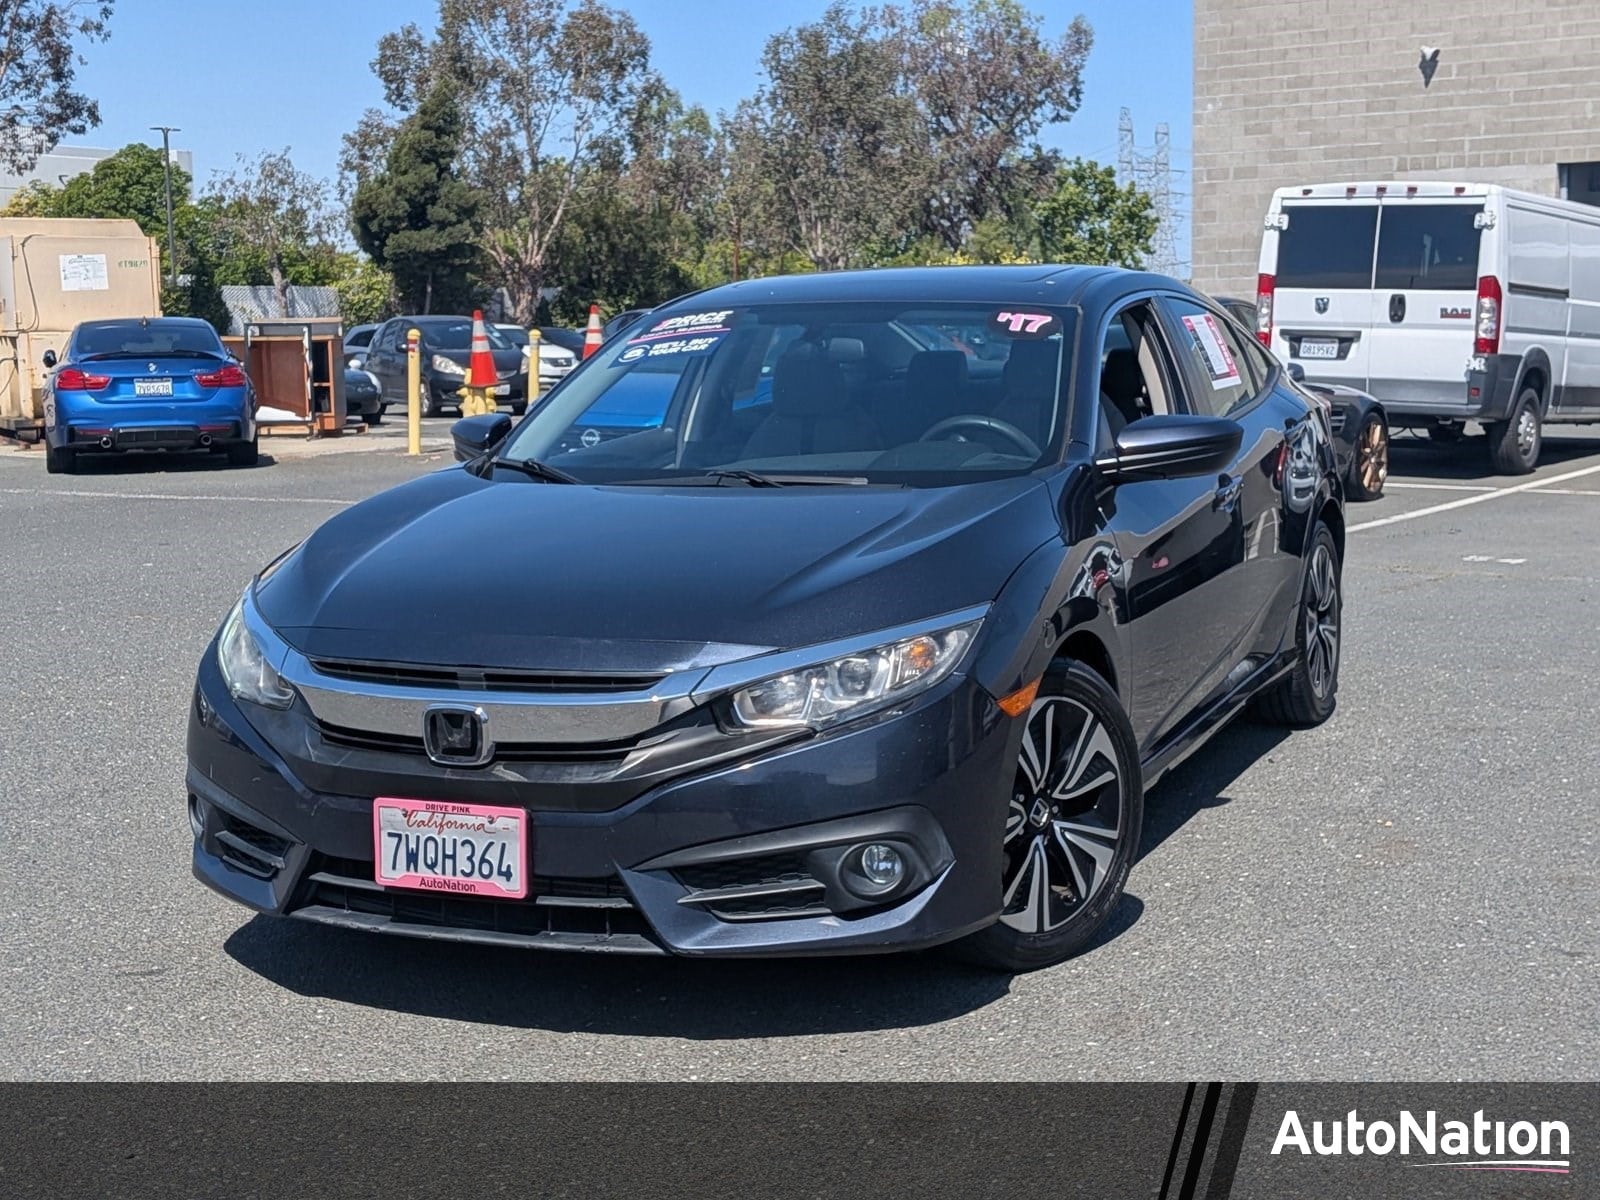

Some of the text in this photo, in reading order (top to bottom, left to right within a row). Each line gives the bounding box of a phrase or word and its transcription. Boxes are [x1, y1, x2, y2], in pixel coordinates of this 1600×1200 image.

[1440, 307, 1472, 319] RAM
[688, 337, 719, 346] BUY
[647, 343, 709, 357] YOUR CAR
[425, 803, 471, 814] DRIVE PINK
[405, 810, 496, 835] California
[387, 831, 513, 882] 7WQH364
[419, 877, 477, 892] AutoNation
